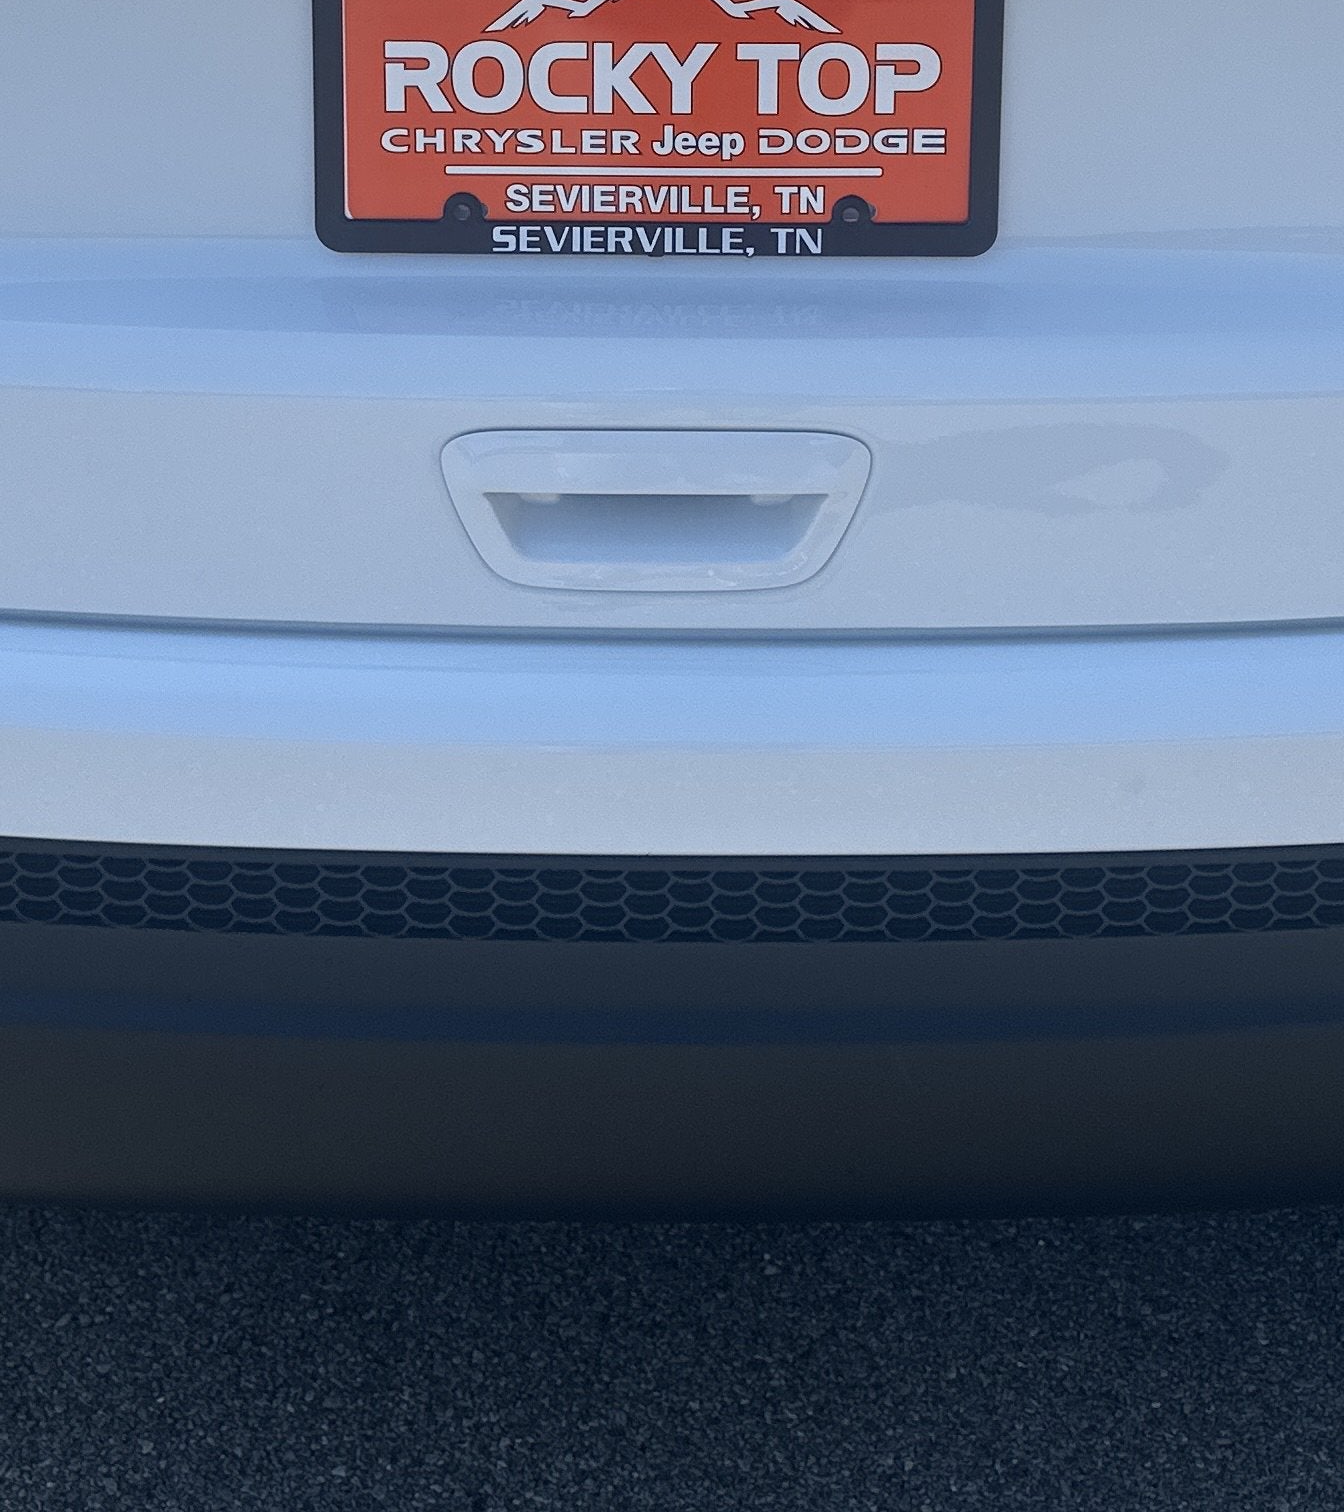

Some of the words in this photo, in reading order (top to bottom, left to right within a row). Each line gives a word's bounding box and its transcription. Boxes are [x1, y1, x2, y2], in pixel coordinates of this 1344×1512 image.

[383, 40, 719, 115] ROCKY
[736, 42, 943, 116] TOP
[381, 127, 640, 155] CHRYSLER
[652, 124, 745, 160] Jeep
[758, 128, 947, 155] DODGE
[505, 183, 761, 219] SEVIERVILLE,
[774, 186, 825, 215] TN
[491, 225, 755, 258] SEVIERVILLE,
[770, 228, 823, 255] TN
